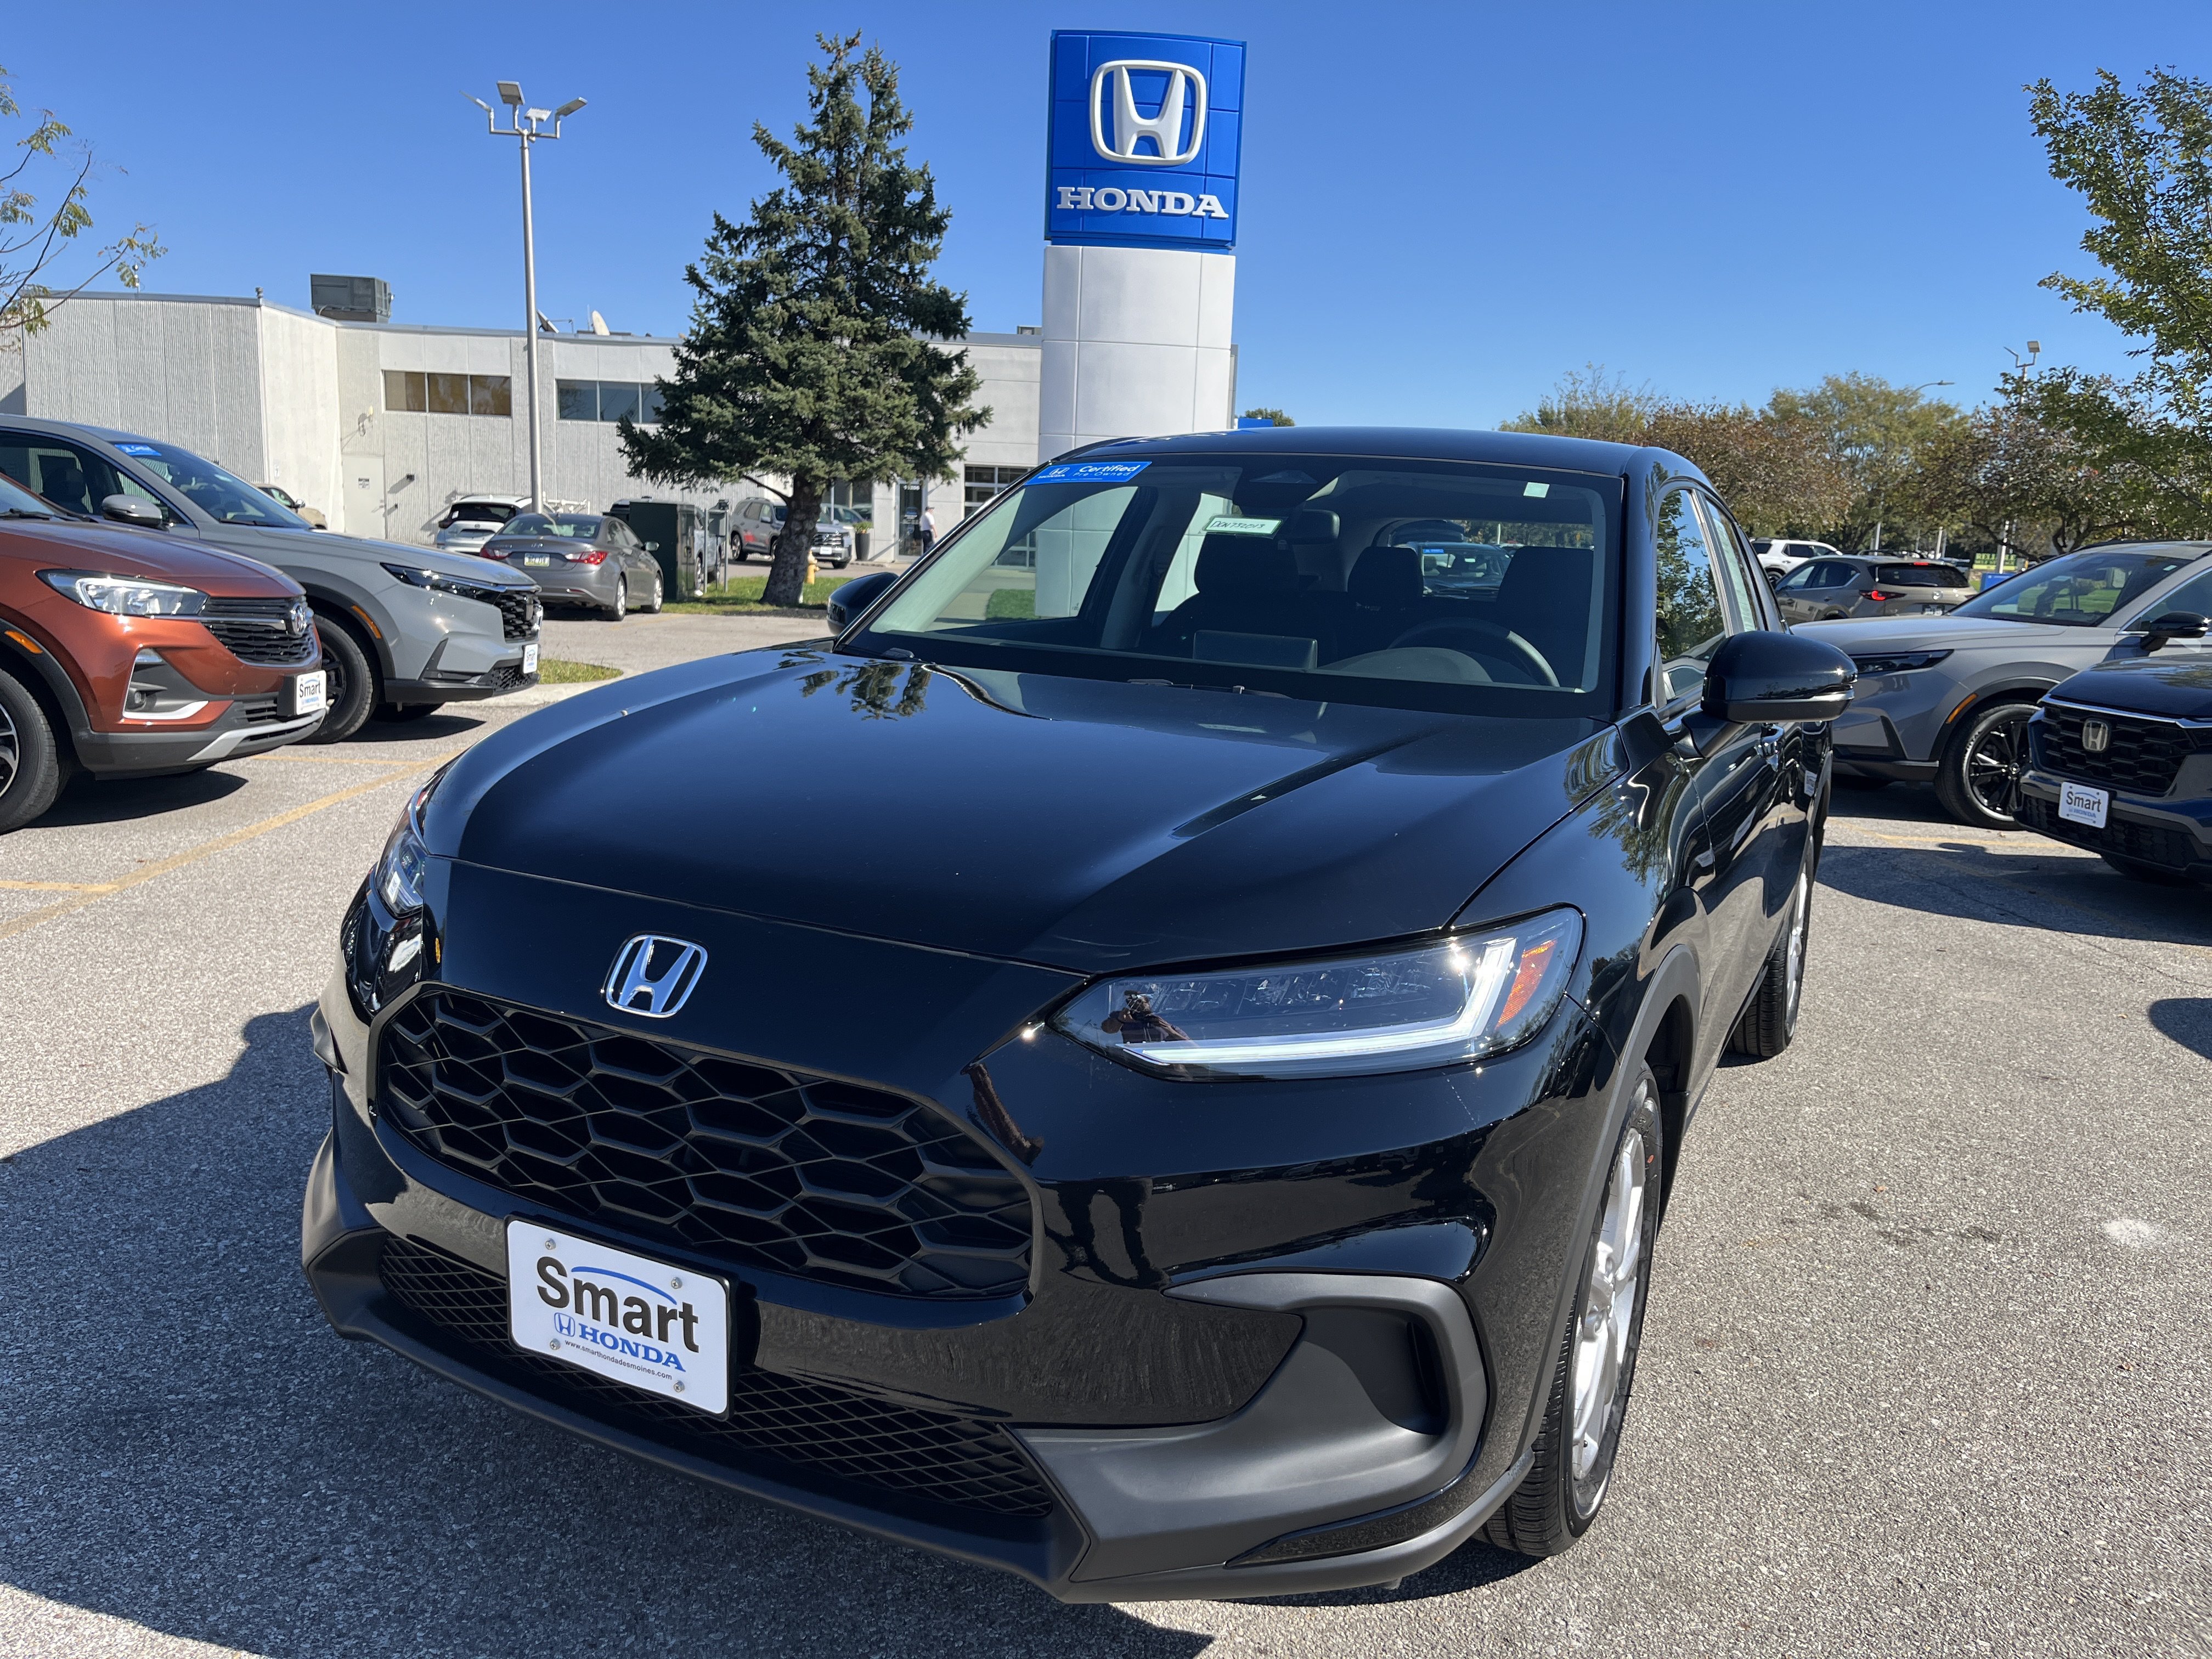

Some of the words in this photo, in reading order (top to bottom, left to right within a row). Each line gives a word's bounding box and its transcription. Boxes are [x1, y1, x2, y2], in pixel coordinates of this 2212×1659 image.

[1056, 187, 1229, 219] HONDA
[300, 680, 321, 698] Smart
[2066, 791, 2102, 812] Smart
[2074, 808, 2096, 818] HONDA
[537, 1256, 699, 1353] Smart
[565, 1340, 673, 1380] www.smarthondadesmoines.com
[578, 1323, 686, 1372] HONDA
